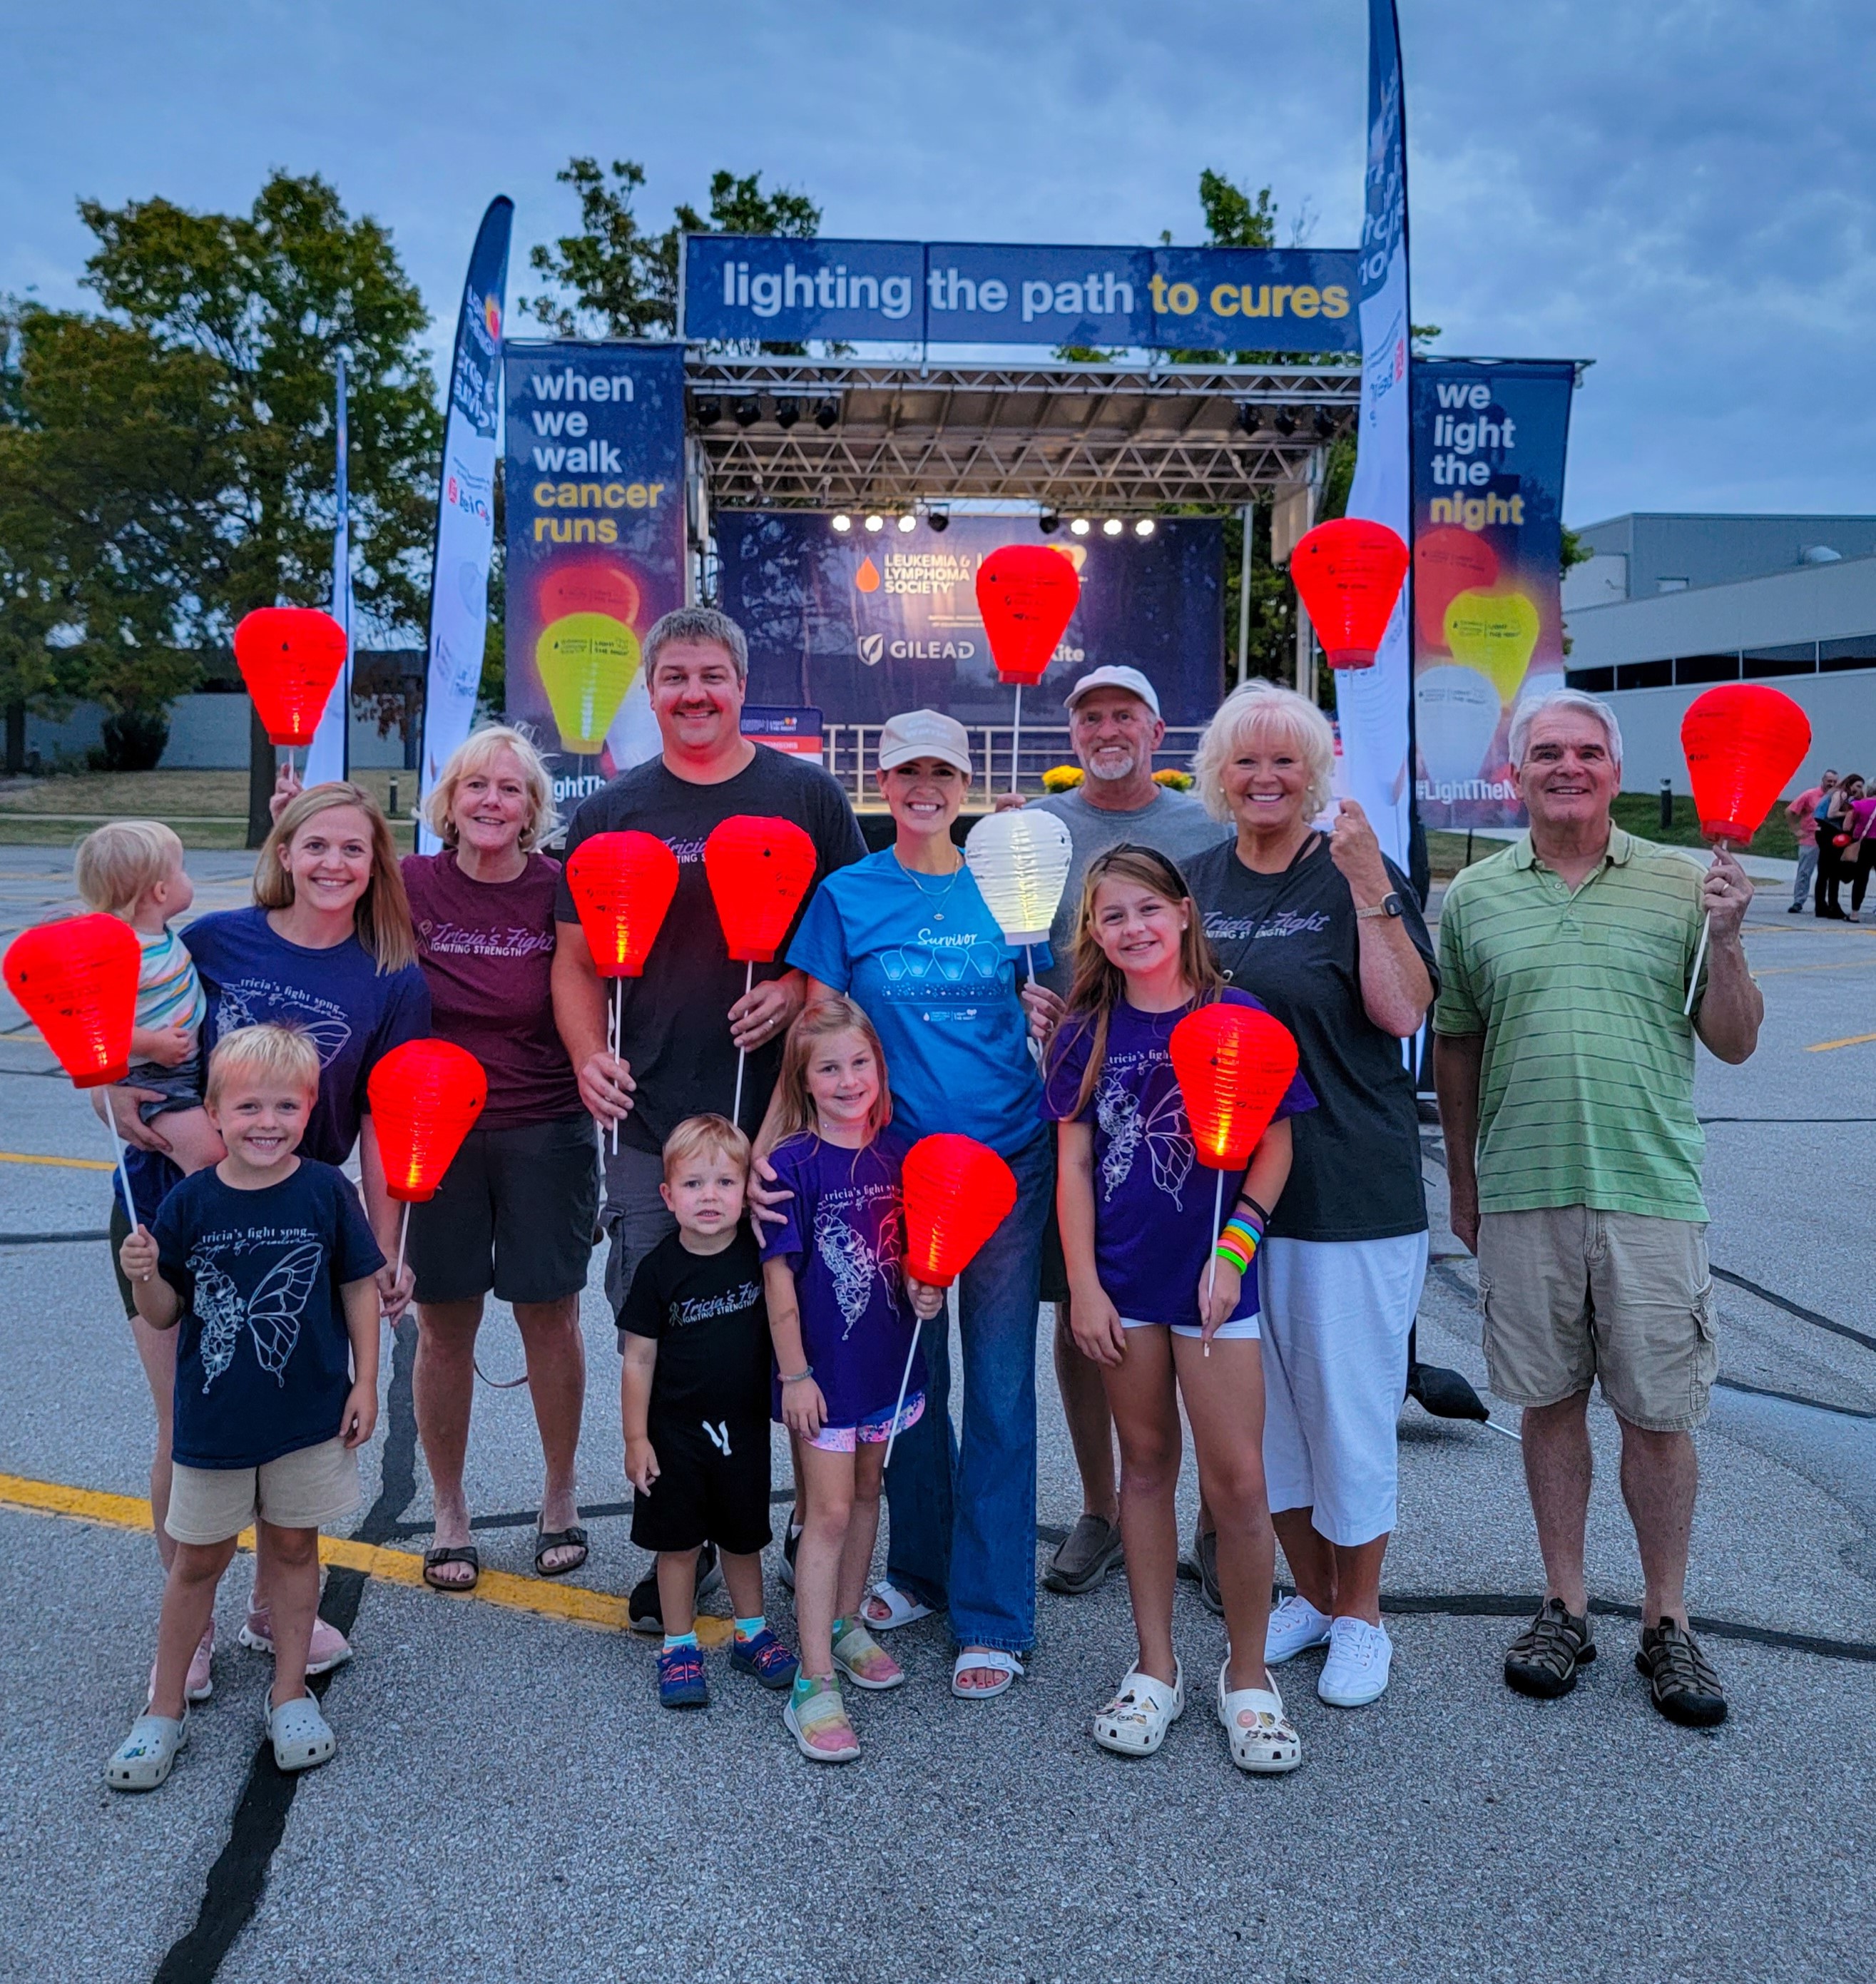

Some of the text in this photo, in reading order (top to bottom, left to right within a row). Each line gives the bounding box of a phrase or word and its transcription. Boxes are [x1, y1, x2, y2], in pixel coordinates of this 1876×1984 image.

[723, 262, 1350, 322] lighting the path to cures
[532, 367, 634, 402] when
[1437, 383, 1491, 409] we
[532, 410, 588, 437] we
[1434, 414, 1516, 455] light
[532, 439, 623, 473] walk
[1430, 453, 1491, 487] the
[534, 482, 664, 509] cancer
[1430, 490, 1525, 531] night
[534, 517, 618, 544] runs
[885, 554, 970, 568] LEUKEMIA &
[885, 567, 969, 581] LYMPHOMA
[885, 581, 950, 594] SOCIETY
[889, 641, 975, 659] GILEAD
[1416, 779, 1517, 805] #LightTheN
[1274, 910, 1330, 936] Fight
[431, 942, 523, 957] IGNITING STRENGTH
[432, 922, 555, 955] Tricia's Fight
[917, 927, 977, 946] Survivor
[285, 985, 310, 1002] fight
[315, 997, 341, 1013] song
[1109, 1050, 1145, 1064] tricia's
[825, 1186, 862, 1201] tricia's
[864, 1183, 884, 1196] fight
[203, 1226, 308, 1244] tricia's fight song
[681, 1289, 736, 1317] Tricia's
